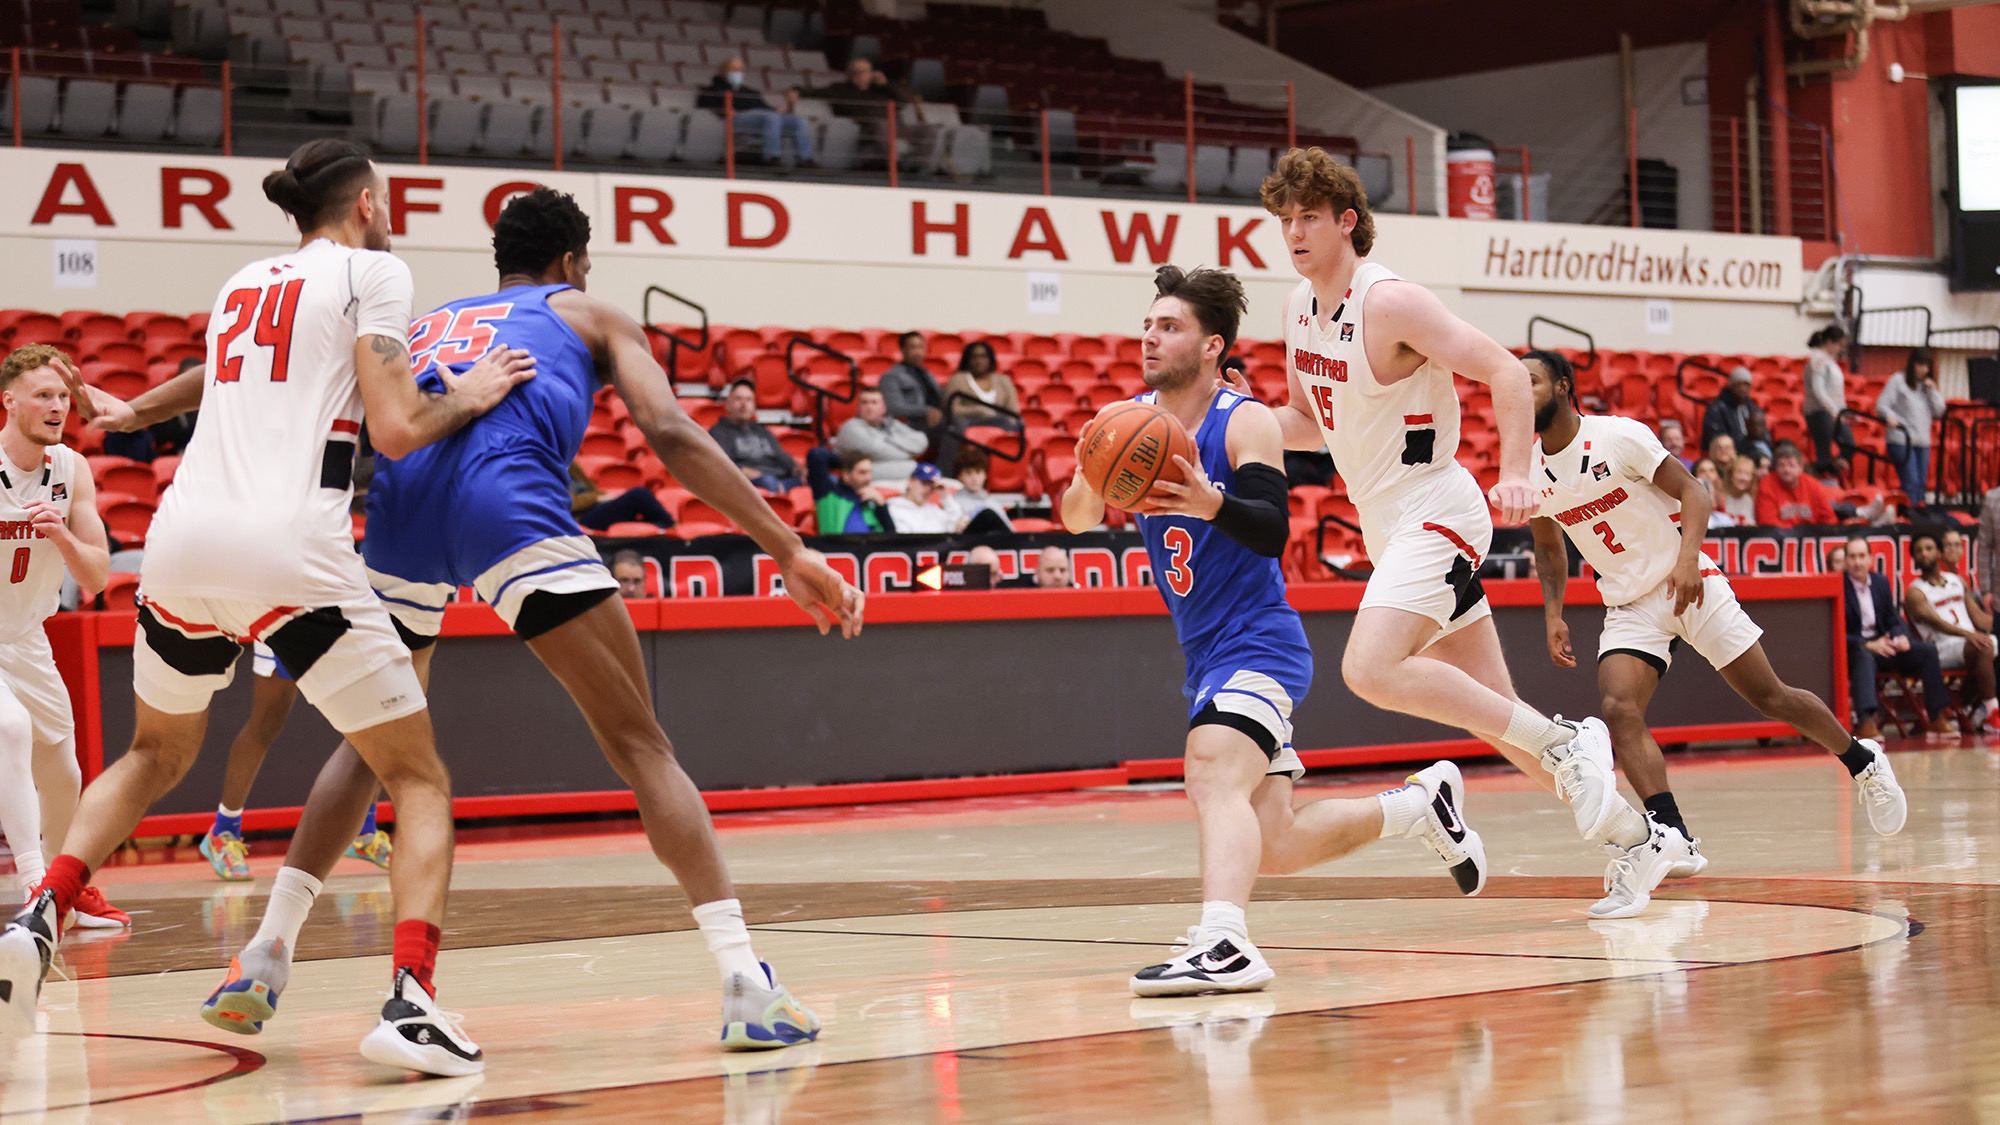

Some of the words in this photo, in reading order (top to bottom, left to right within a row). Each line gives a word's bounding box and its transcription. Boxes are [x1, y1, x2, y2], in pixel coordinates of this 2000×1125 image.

[58, 252, 95, 276] 108
[1485, 237, 1782, 289] HartfordHawks.com
[214, 278, 305, 386] 24
[407, 302, 514, 378] 25
[1295, 348, 1348, 383] HARTFORD
[1311, 385, 1334, 431] 15
[1130, 435, 1160, 471] THE
[1109, 467, 1146, 502] ROCK
[1554, 486, 1629, 527] HARTFORD
[1592, 520, 1626, 555] 2
[10, 547, 31, 584] 0
[1163, 526, 1194, 597] 3
